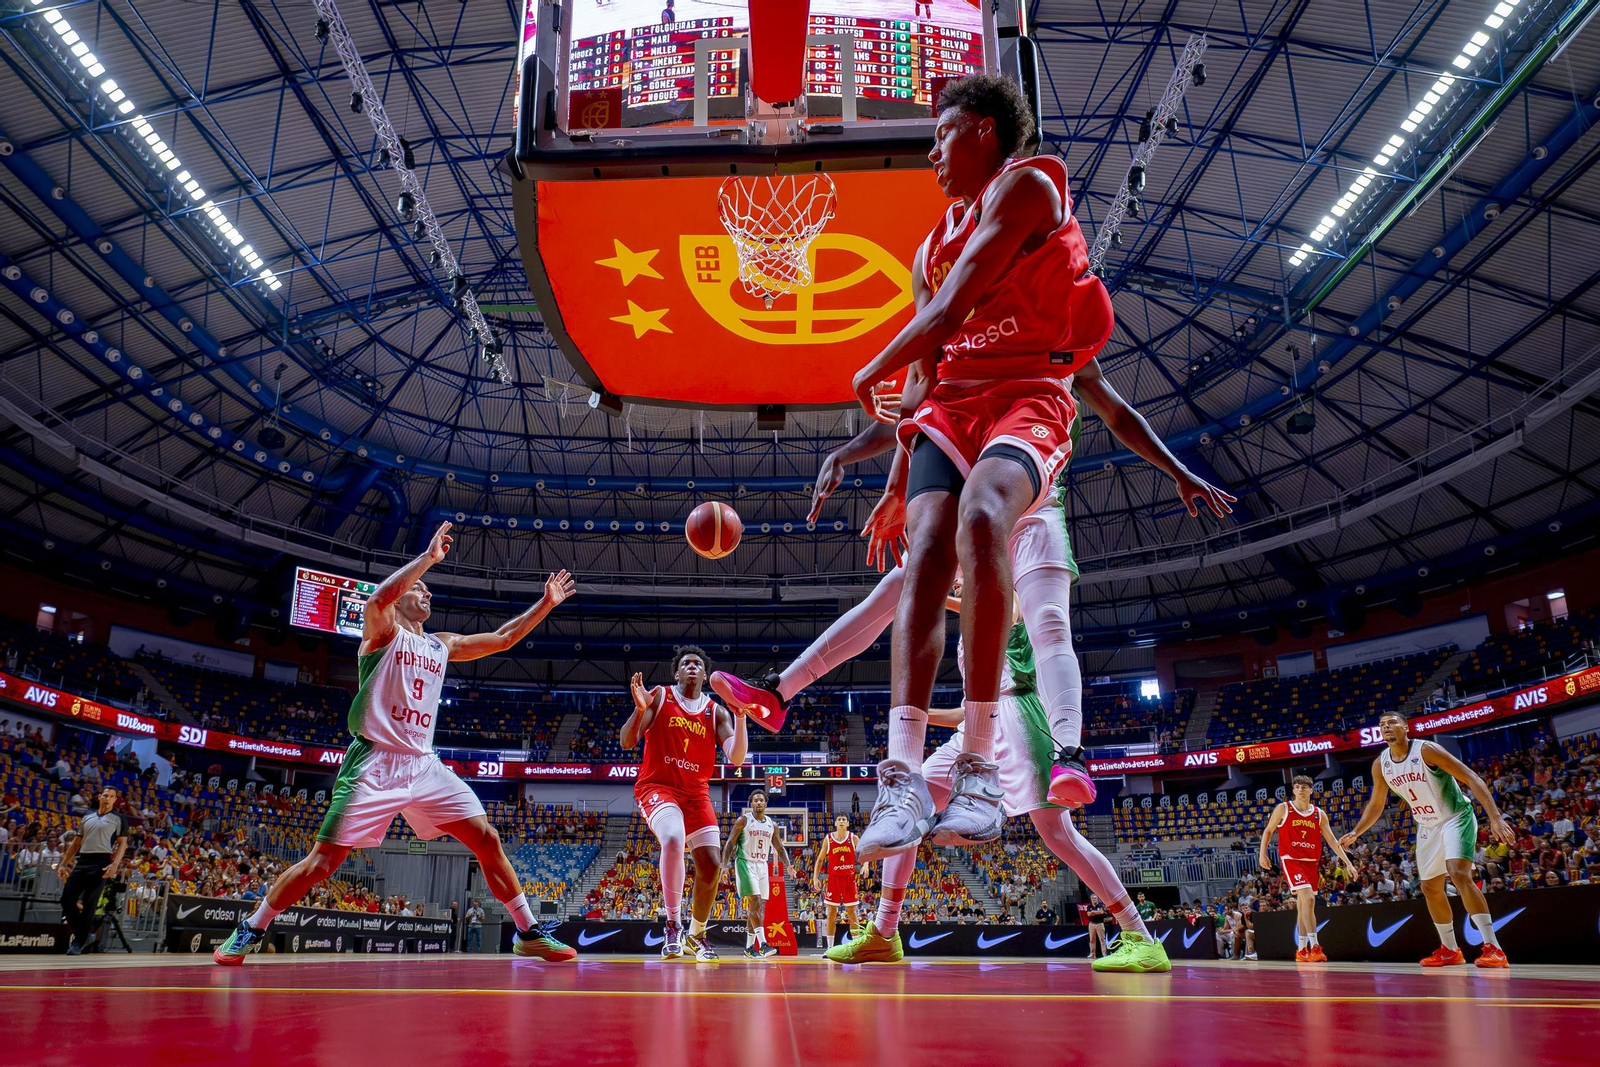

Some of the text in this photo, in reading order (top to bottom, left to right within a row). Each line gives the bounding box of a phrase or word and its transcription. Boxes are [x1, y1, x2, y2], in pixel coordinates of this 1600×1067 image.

[651, 21, 696, 33] FOLGUEIRAS
[834, 17, 857, 26] BRITO
[940, 28, 972, 40] GAMEIRO
[651, 45, 676, 56] MILLER
[940, 50, 961, 61] SILVA
[943, 62, 963, 72] NUNO
[695, 246, 721, 283] FEB
[346, 601, 365, 612] 7:01
[412, 678, 424, 700] 9
[24, 686, 57, 707] AVIS
[1514, 687, 1548, 710] AVIS
[117, 714, 155, 734] Wilson
[668, 716, 706, 738] ESPAÑA
[179, 726, 207, 745] SDI
[1360, 726, 1383, 744] SD
[684, 738, 689, 753] 1
[1289, 740, 1334, 754] Wilson
[664, 756, 699, 772] endesa
[1184, 752, 1218, 766] AVIS
[478, 762, 504, 776] SDI
[608, 767, 637, 777] AVIS
[734, 767, 742, 777] 4
[828, 767, 842, 777] 15
[768, 775, 783, 787] 15
[1409, 788, 1418, 801] 1
[1301, 830, 1307, 838] 7
[758, 840, 763, 849] 5
[204, 907, 234, 920] endesa
[722, 924, 748, 933] endes
[0, 934, 55, 947] LaFamilia
